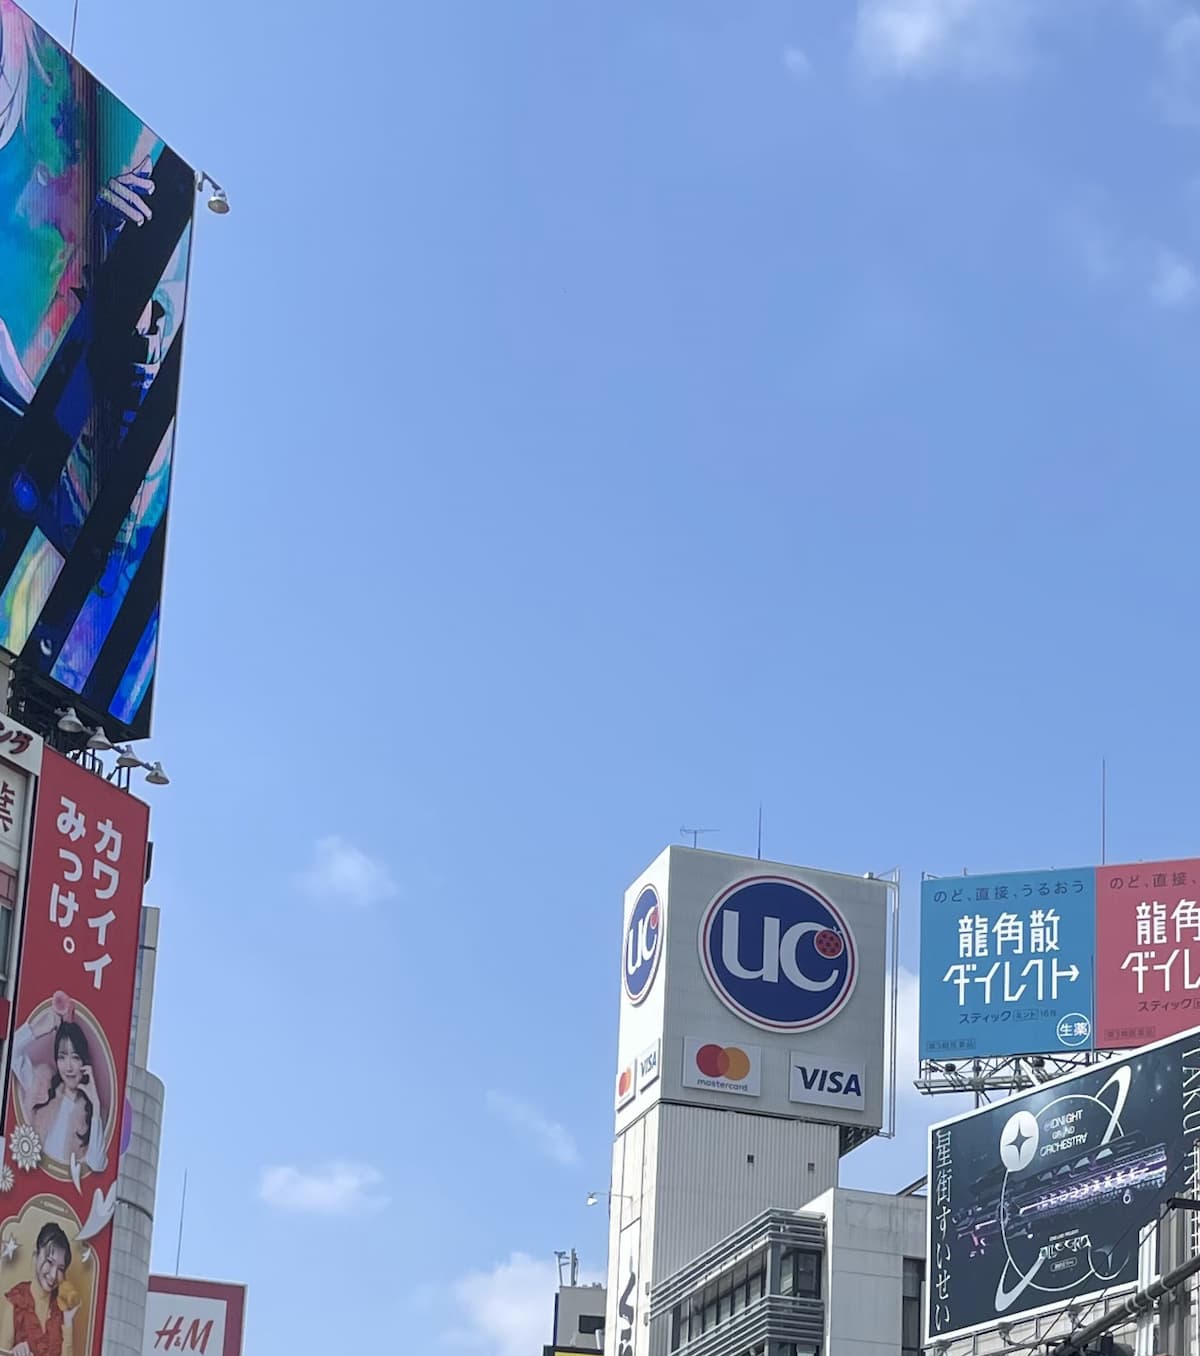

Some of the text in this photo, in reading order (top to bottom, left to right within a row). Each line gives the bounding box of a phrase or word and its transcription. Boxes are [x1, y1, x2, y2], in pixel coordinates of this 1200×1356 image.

[84, 818, 123, 990] カワイイ
[958, 908, 1061, 958] 龍角散
[943, 958, 1080, 1005] ダイレクト
[959, 1011, 1012, 1024] スティック
[1060, 1020, 1089, 1037] 生薬
[697, 1079, 748, 1092] mastercard
[794, 1065, 862, 1097] VISA
[935, 1130, 953, 1331] 星街すいせい
[153, 1314, 217, 1356] H&M
